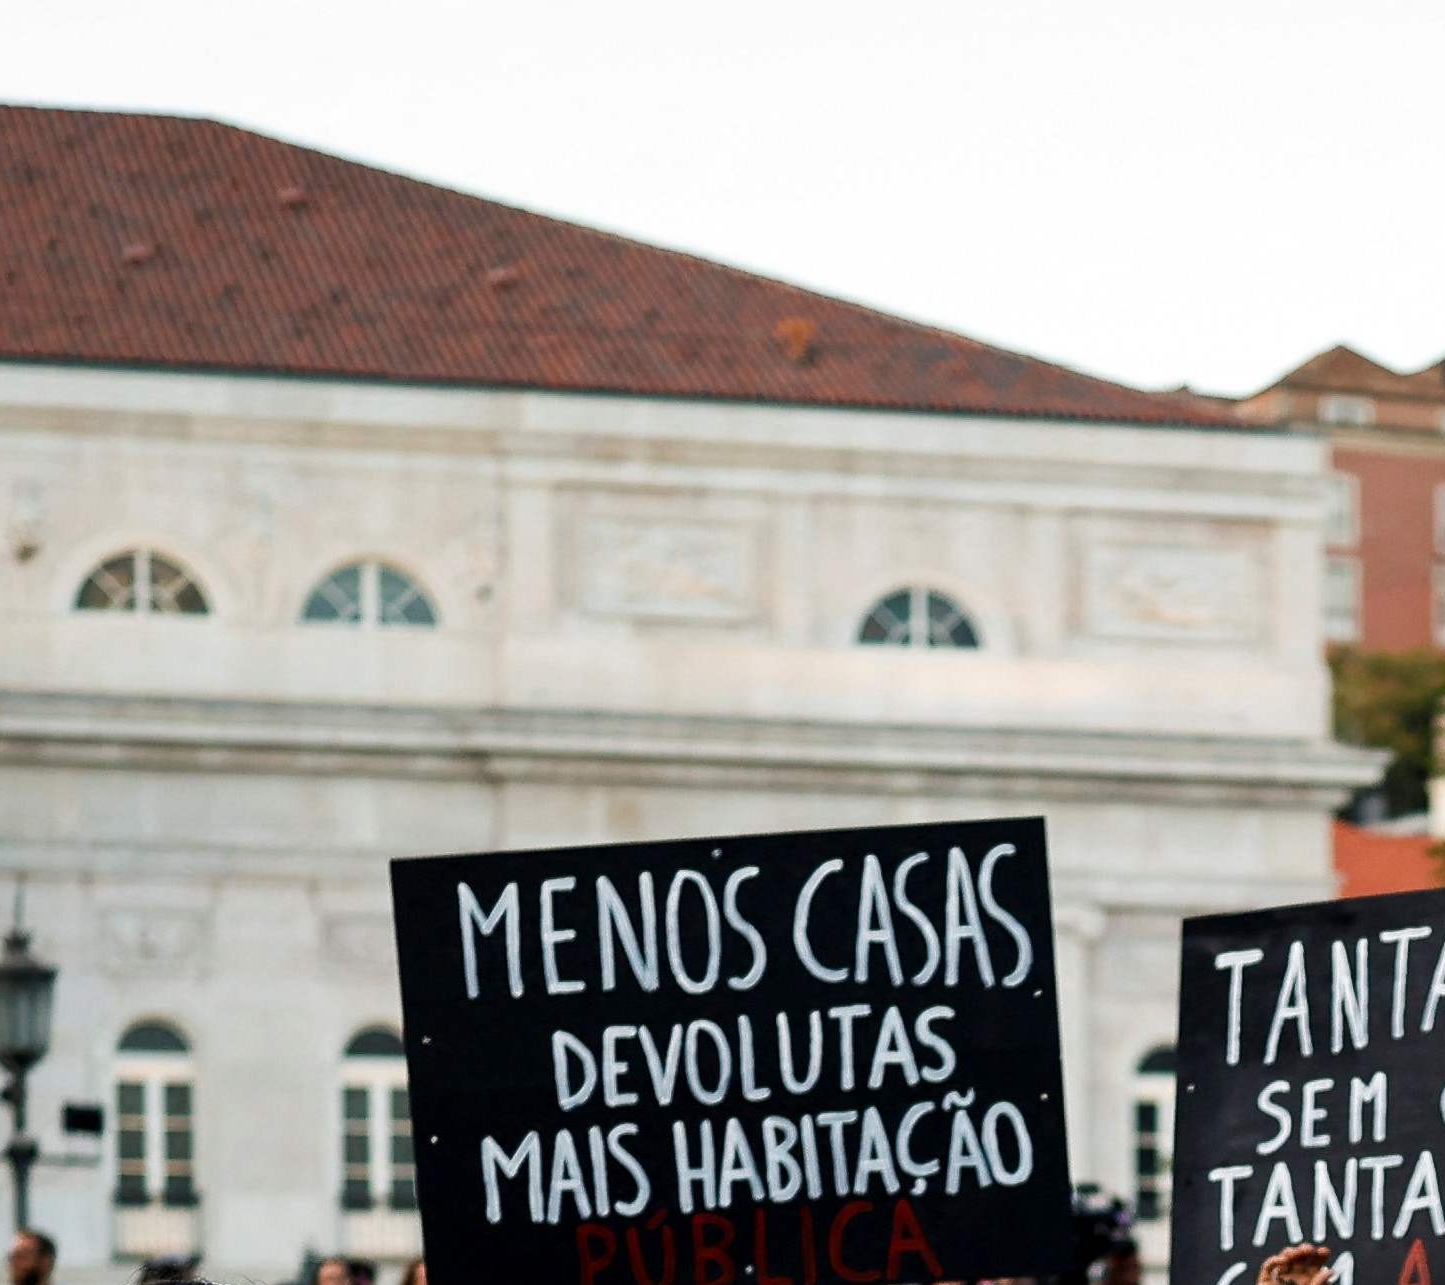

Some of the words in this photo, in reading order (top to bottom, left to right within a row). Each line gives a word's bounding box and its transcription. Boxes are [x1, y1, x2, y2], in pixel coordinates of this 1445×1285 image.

[457, 866, 768, 998] MENOS
[793, 842, 1034, 988] CASAS
[551, 1005, 958, 1111] DEVOLUTAS
[1255, 1070, 1388, 1155] SEM
[481, 1123, 651, 1224] MAIS
[673, 1088, 1033, 1214] HABITAÇÃO
